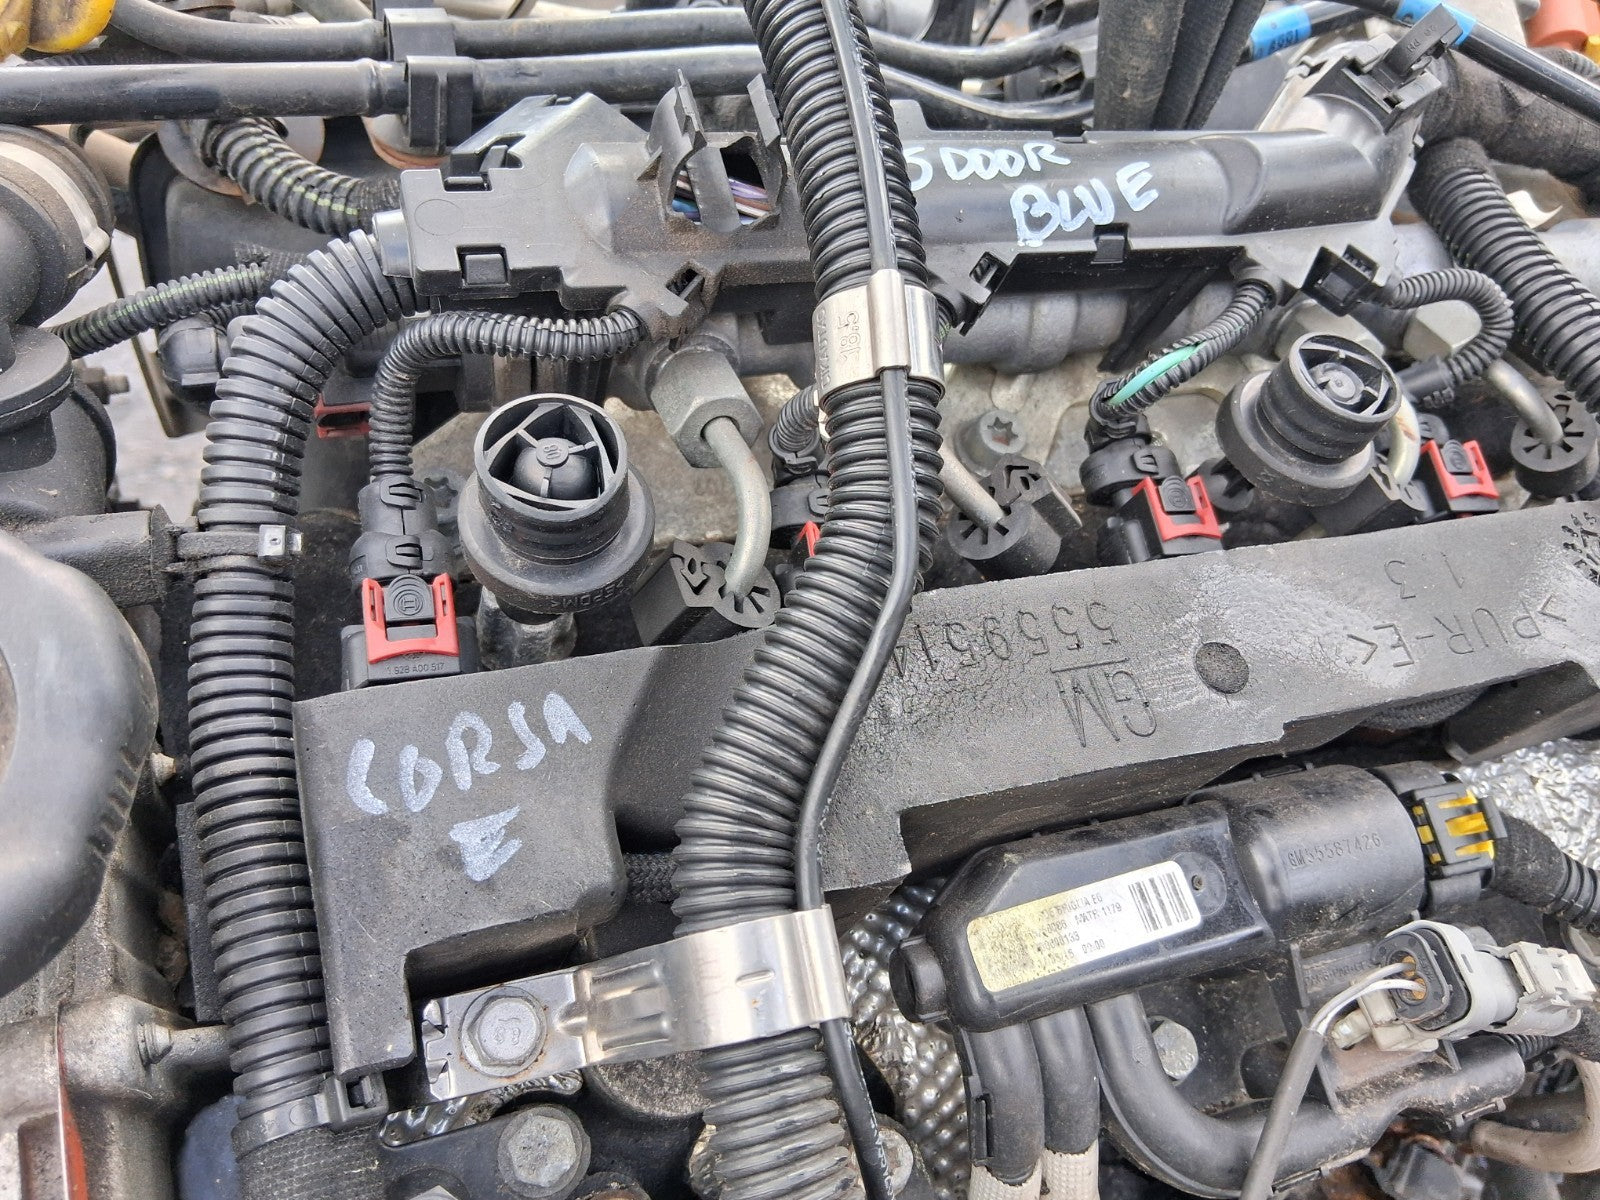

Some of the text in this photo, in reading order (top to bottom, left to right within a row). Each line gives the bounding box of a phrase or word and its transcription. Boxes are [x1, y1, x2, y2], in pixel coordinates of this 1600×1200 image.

[940, 143, 1071, 180] DOOR
[1009, 161, 1159, 247] BLUE
[1055, 669, 1157, 748] GM
[346, 690, 593, 815] CORSA
